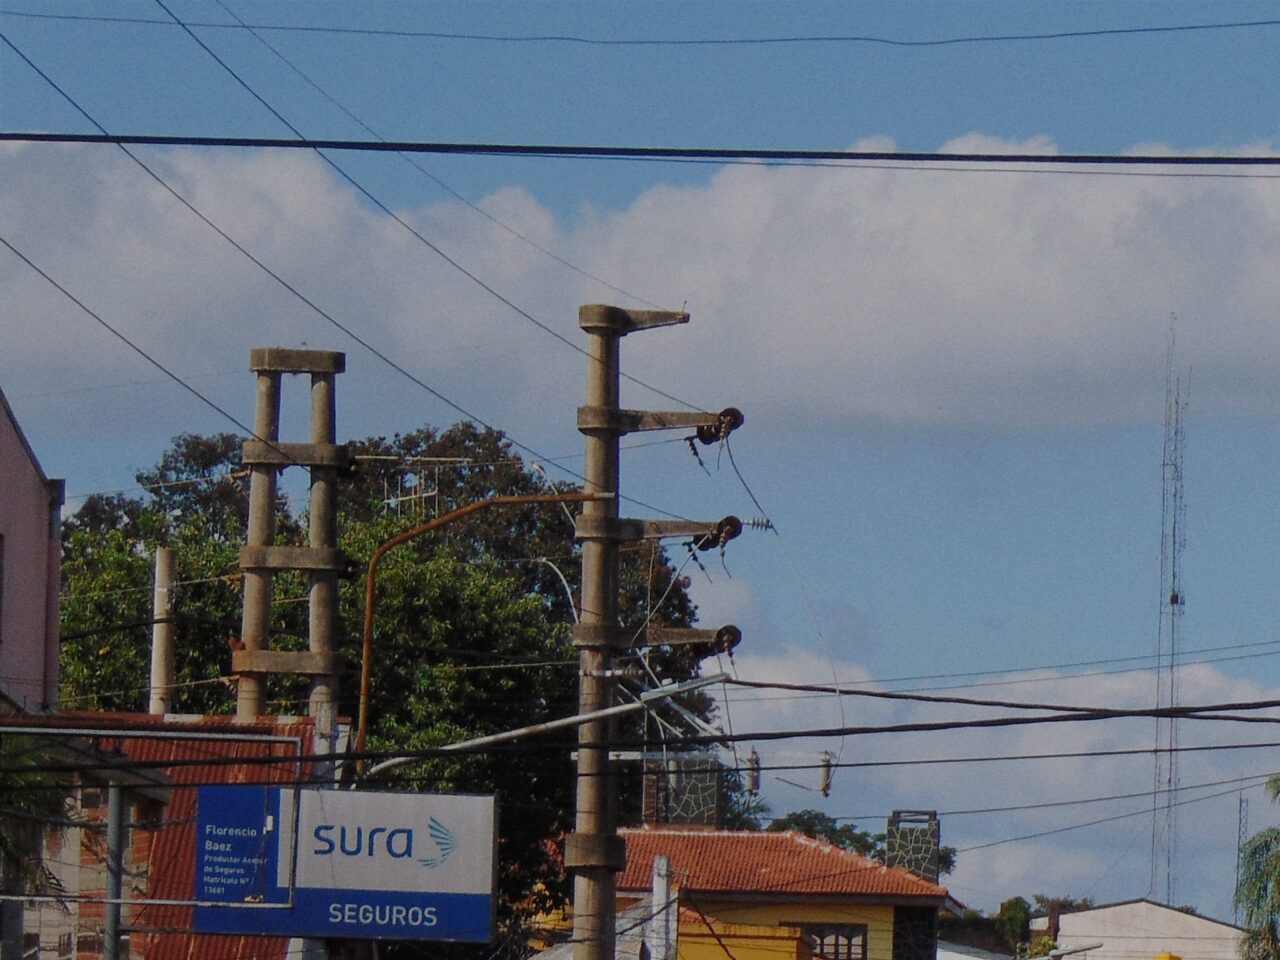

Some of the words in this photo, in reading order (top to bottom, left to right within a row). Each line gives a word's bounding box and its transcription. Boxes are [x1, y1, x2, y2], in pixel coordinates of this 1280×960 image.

[205, 825, 258, 837] Florencio
[205, 840, 233, 852] Baez
[313, 824, 413, 858] sura
[329, 903, 438, 926] SEGUROS
